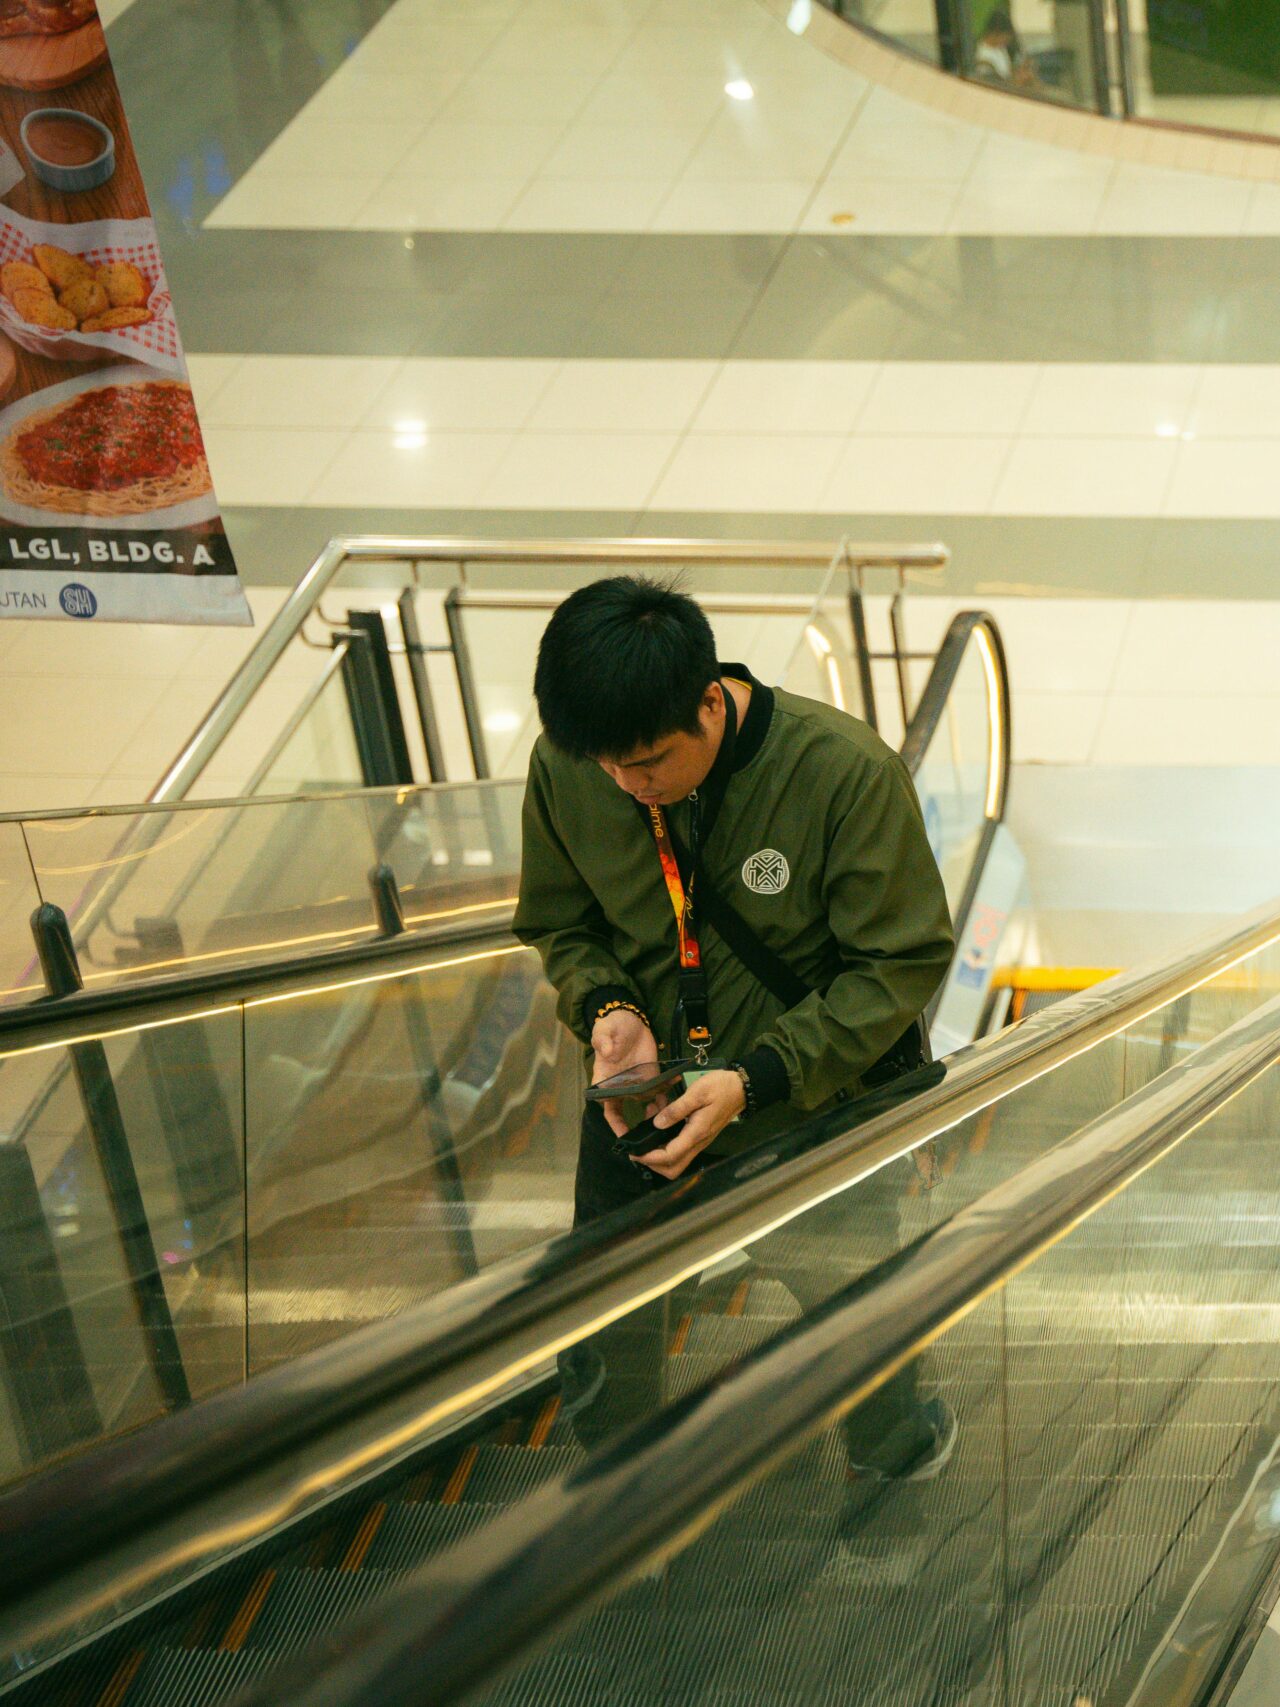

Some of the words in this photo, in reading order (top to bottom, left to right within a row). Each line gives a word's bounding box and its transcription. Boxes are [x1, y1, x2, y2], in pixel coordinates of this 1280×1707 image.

[9, 538, 80, 565] LGL,
[88, 540, 184, 564] BLDG.
[192, 544, 215, 566] A
